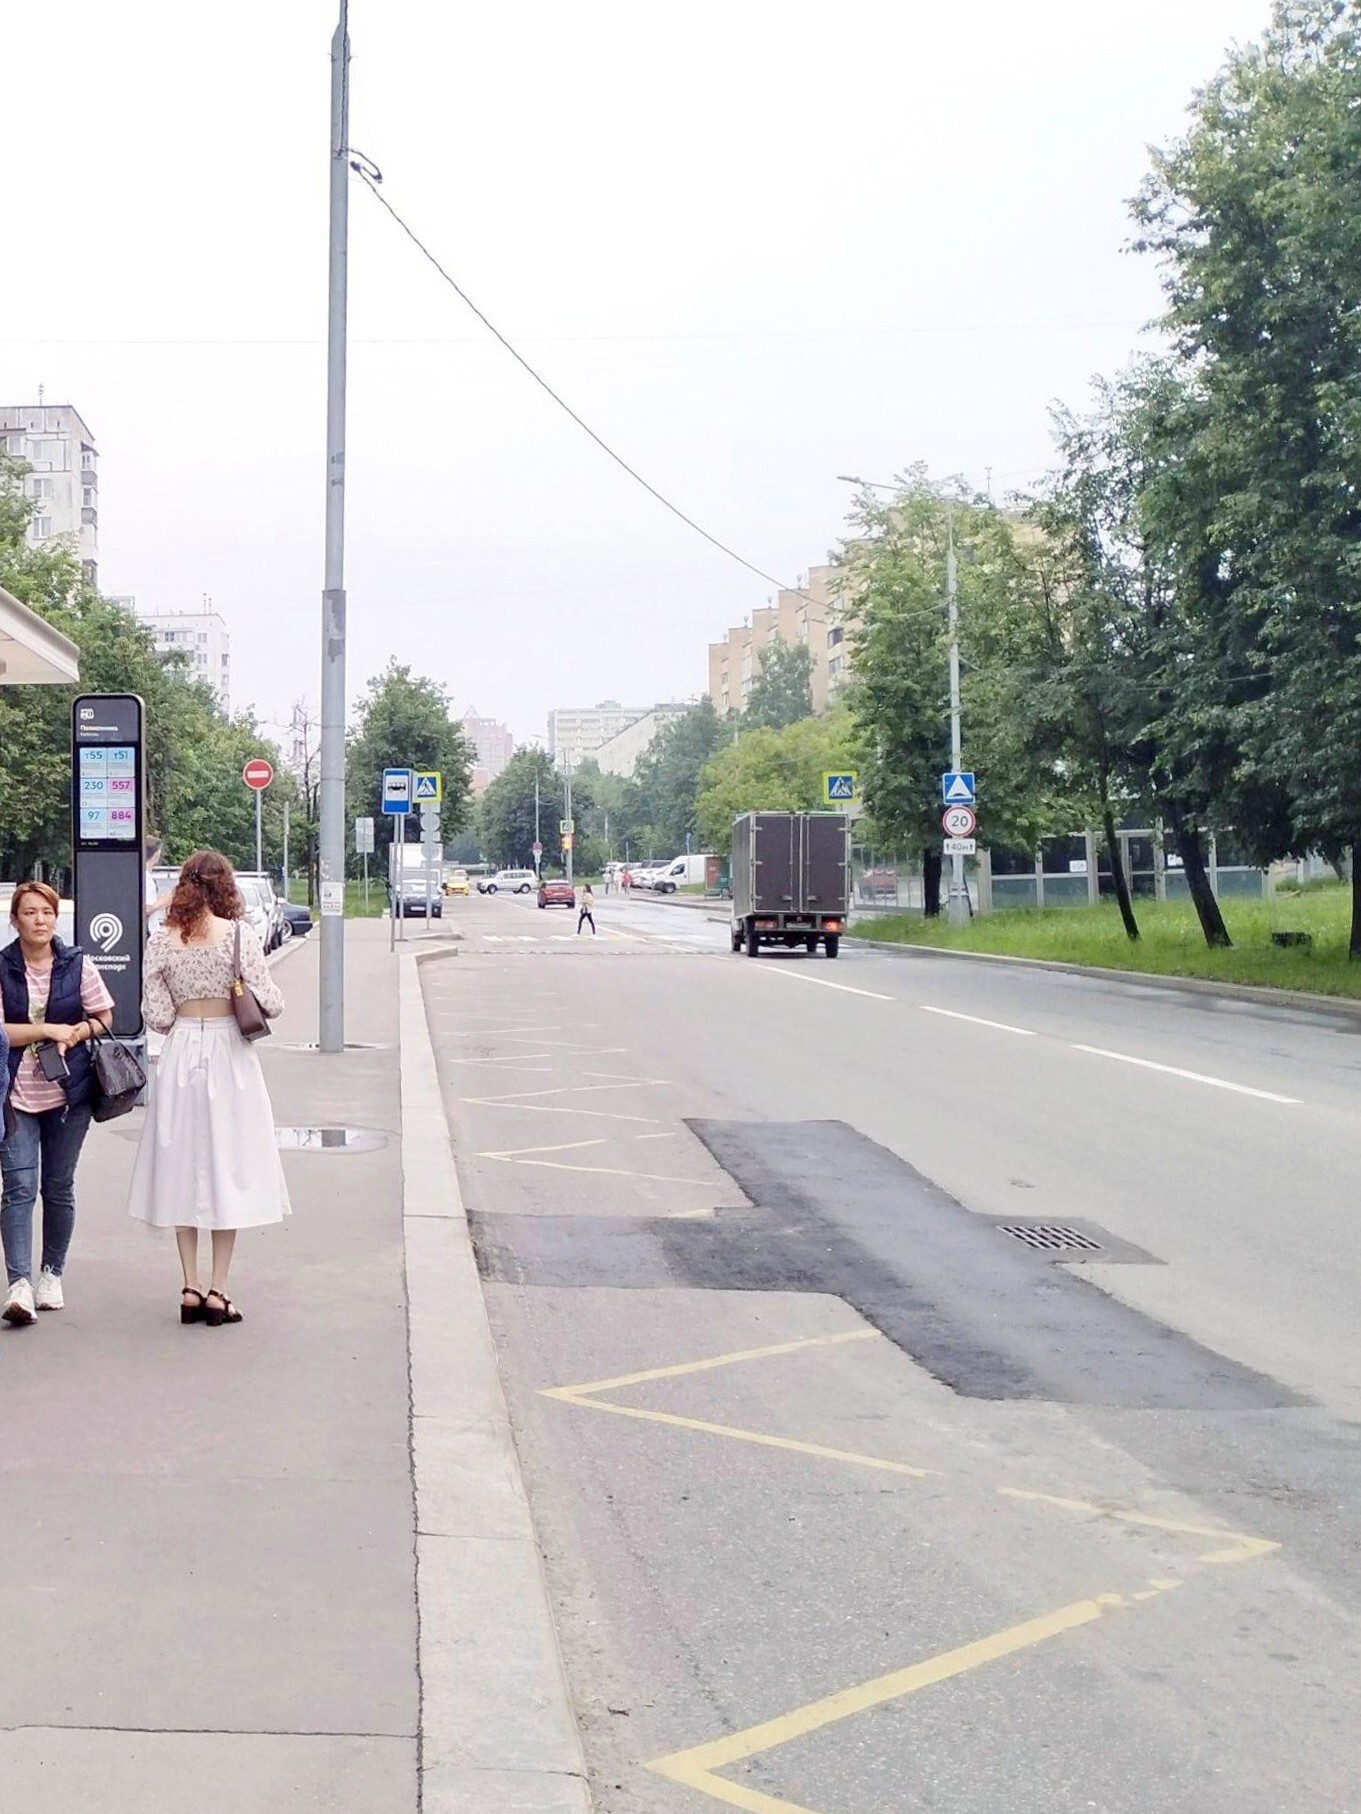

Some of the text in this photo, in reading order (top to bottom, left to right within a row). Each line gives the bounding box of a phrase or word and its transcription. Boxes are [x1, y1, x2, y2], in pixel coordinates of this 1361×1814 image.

[85, 782, 130, 790] 230 557
[88, 812, 131, 820] 97 884
[952, 816, 968, 827] 20
